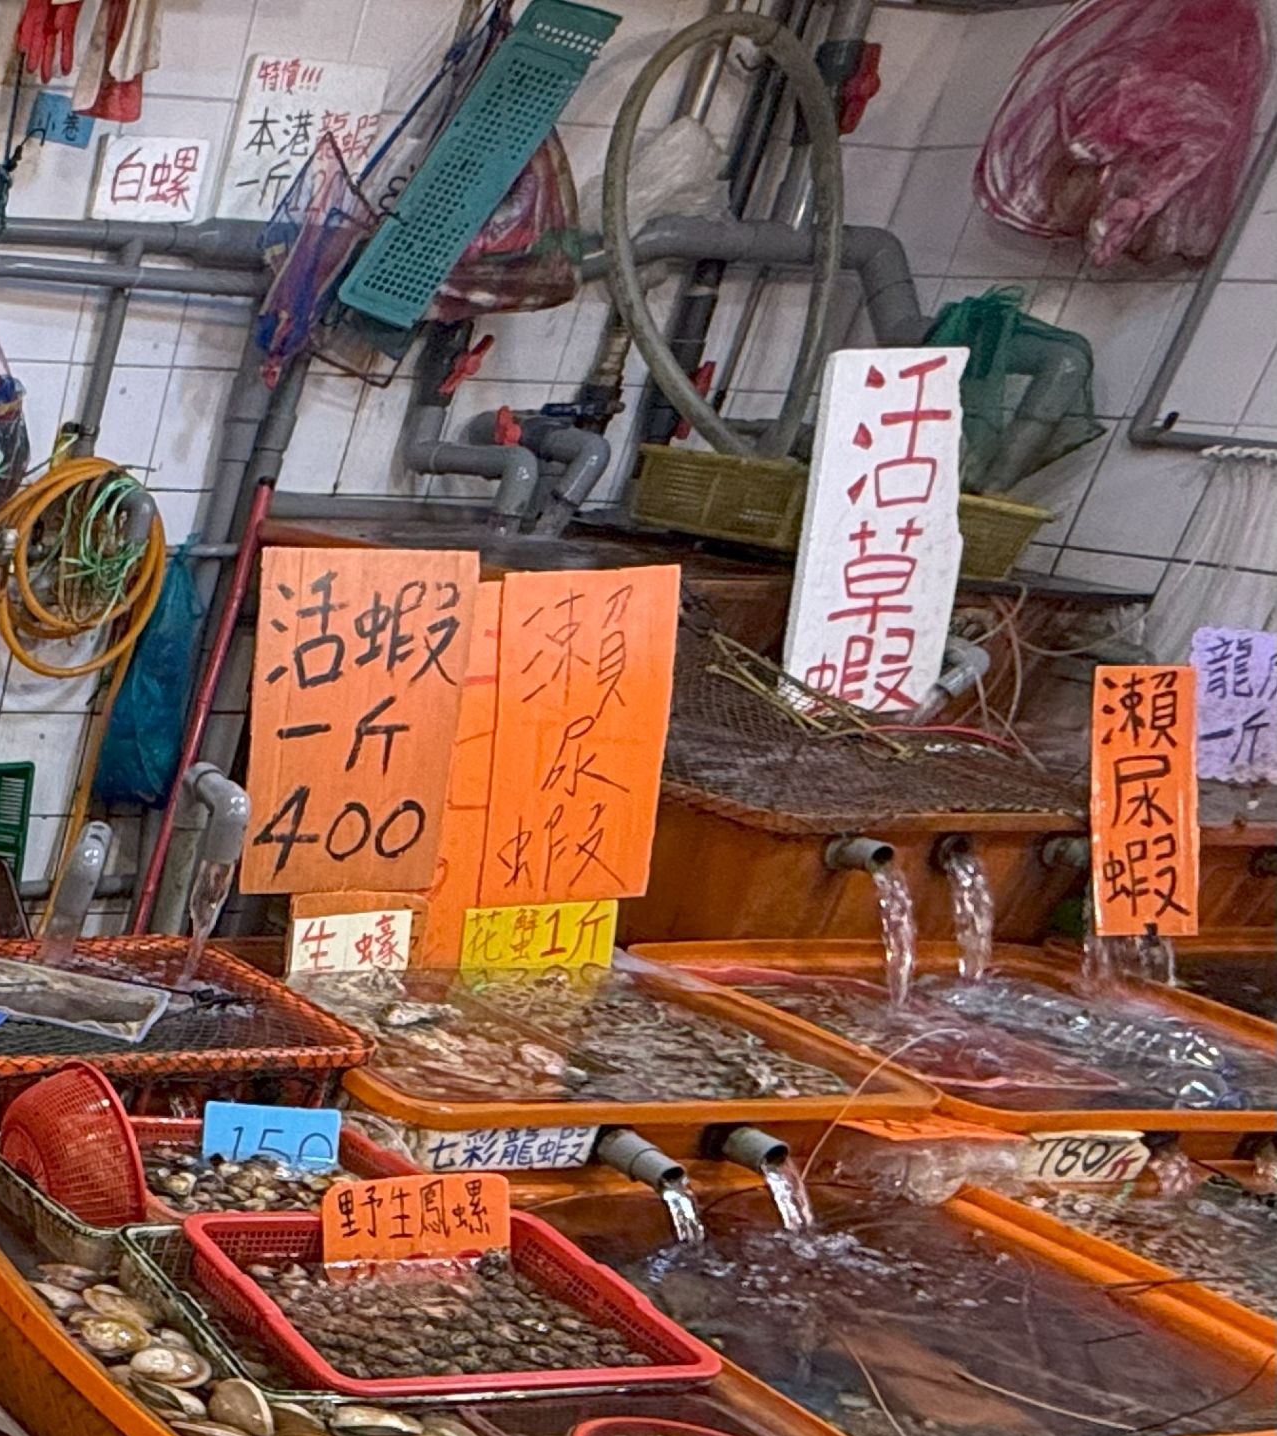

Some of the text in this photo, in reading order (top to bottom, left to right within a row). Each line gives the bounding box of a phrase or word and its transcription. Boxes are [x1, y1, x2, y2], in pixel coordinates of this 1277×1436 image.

[111, 146, 199, 213] 白螺
[801, 354, 952, 717] 活草蝦
[266, 570, 460, 690] 活蝦
[278, 696, 410, 776] 一斤
[253, 784, 427, 878] 400
[1100, 669, 1194, 919] 瀨尿蝦
[427, 1127, 590, 1170] 七彩龍蝦
[336, 1178, 491, 1239] 野生鳳螺
